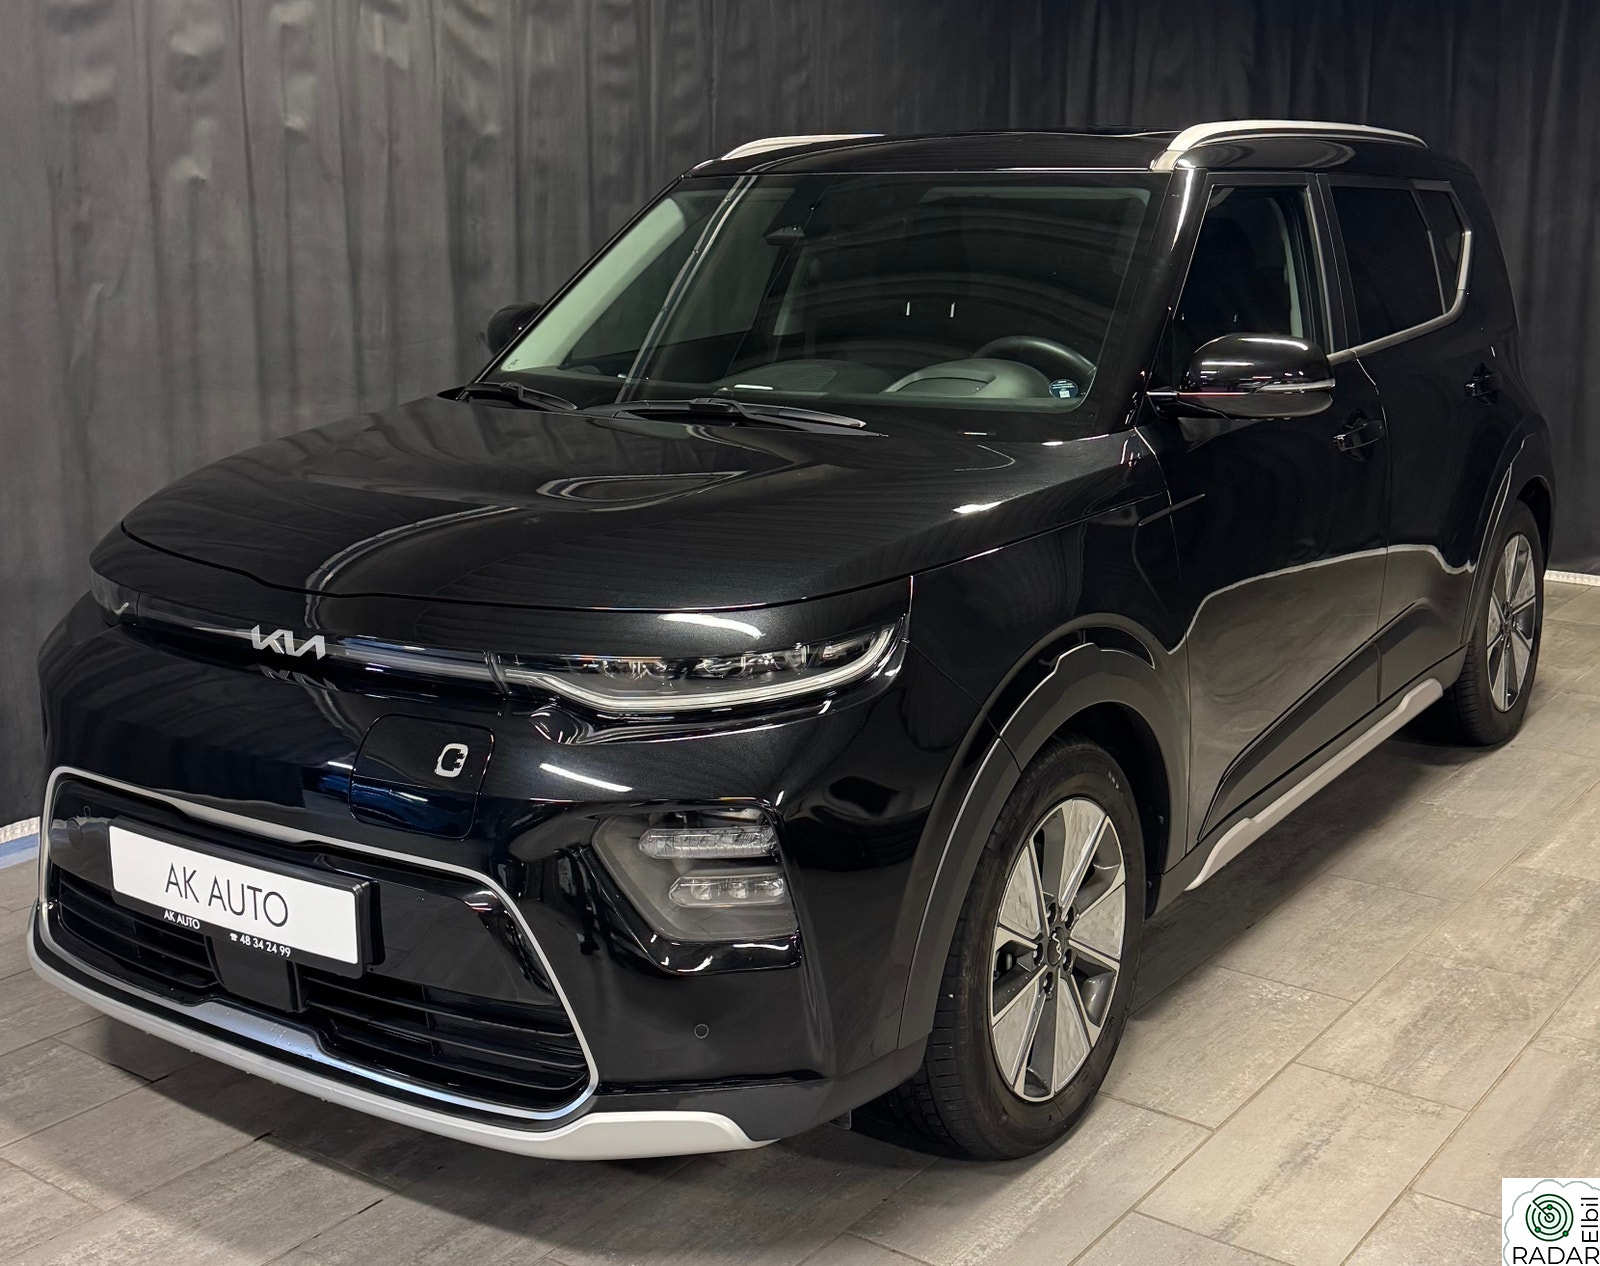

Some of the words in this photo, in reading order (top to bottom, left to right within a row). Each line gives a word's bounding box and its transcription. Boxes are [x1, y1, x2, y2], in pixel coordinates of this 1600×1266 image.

[251, 624, 326, 660] KIA
[165, 862, 200, 903] AK
[208, 875, 289, 928] AUTO
[164, 909, 175, 922] AK
[177, 916, 201, 930] AUTO
[240, 934, 251, 946] 48
[253, 938, 264, 950] 34
[266, 942, 277, 954] 24
[279, 946, 291, 957] 99
